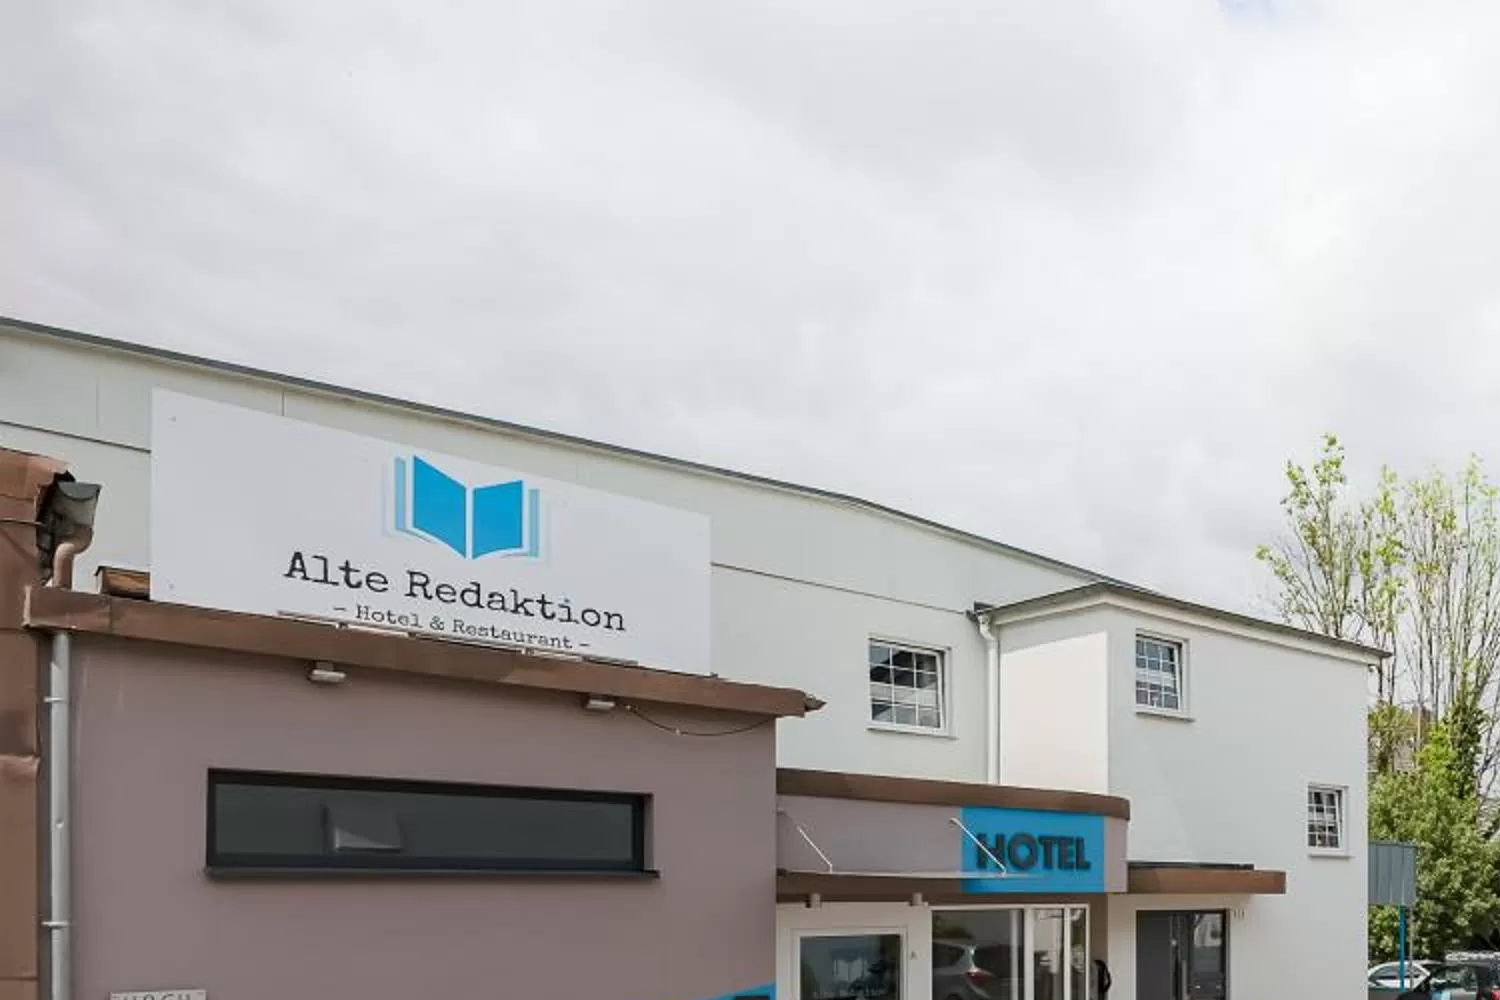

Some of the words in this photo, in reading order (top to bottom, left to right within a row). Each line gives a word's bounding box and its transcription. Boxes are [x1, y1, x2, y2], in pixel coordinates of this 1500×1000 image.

[283, 551, 389, 593] Alte
[404, 569, 626, 632] Redaktion
[355, 604, 424, 629] Hotel
[429, 615, 445, 631] &
[452, 618, 573, 649] Restaurant
[976, 831, 1092, 871] HOTEL
